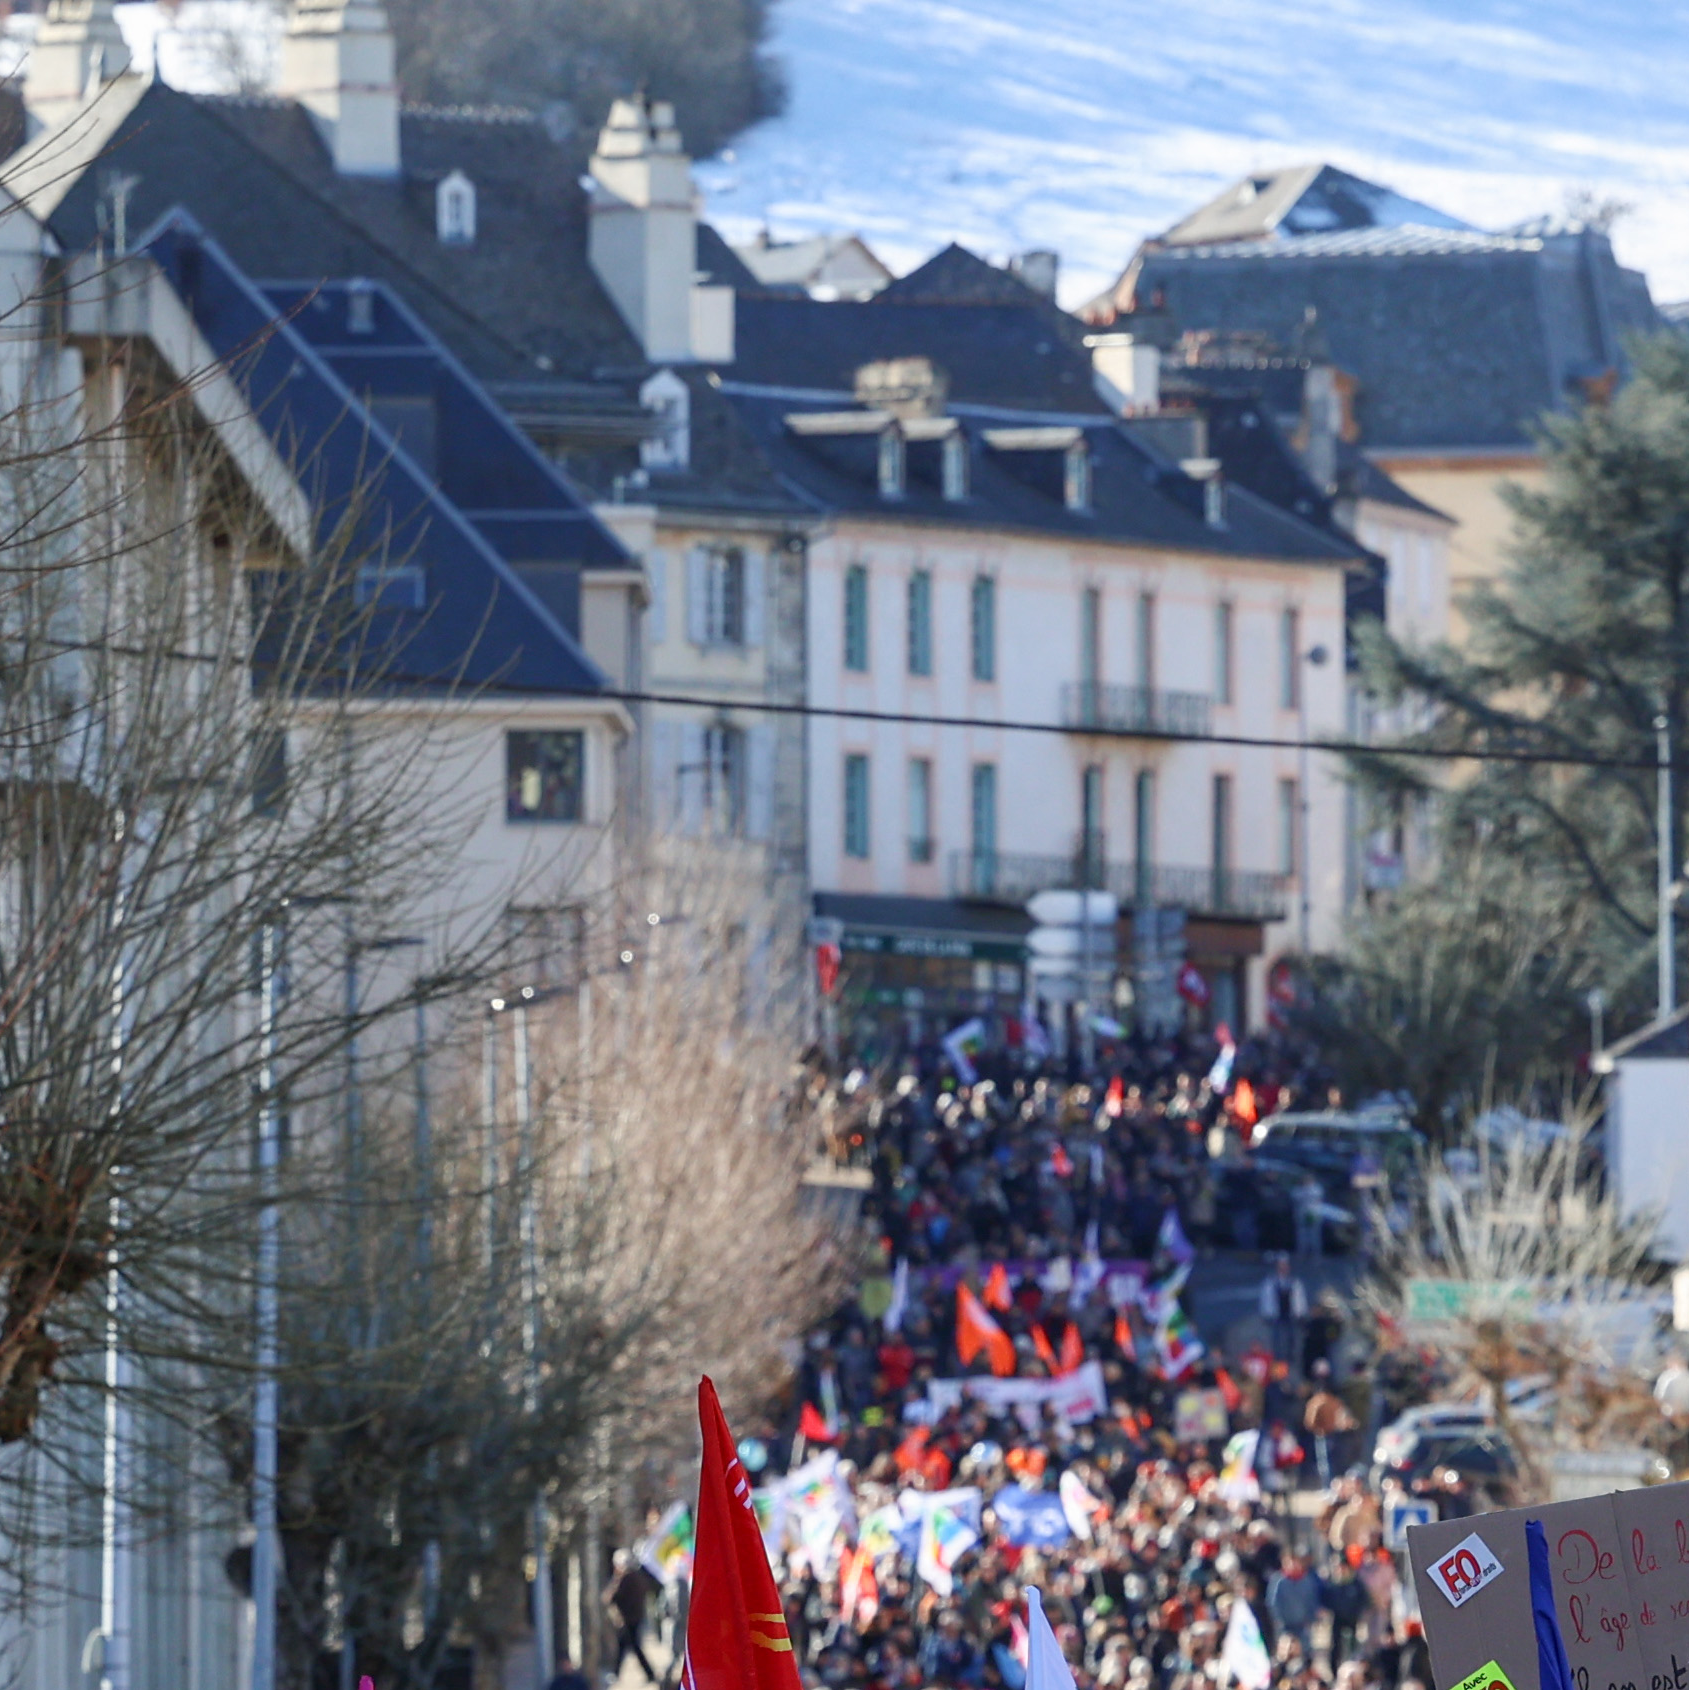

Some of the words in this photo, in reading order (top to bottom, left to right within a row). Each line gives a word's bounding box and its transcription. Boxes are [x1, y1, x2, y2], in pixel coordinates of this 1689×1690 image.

[1438, 1549, 1481, 1601] FO
[1558, 1529, 1616, 1584] De
[1631, 1528, 1661, 1575] la
